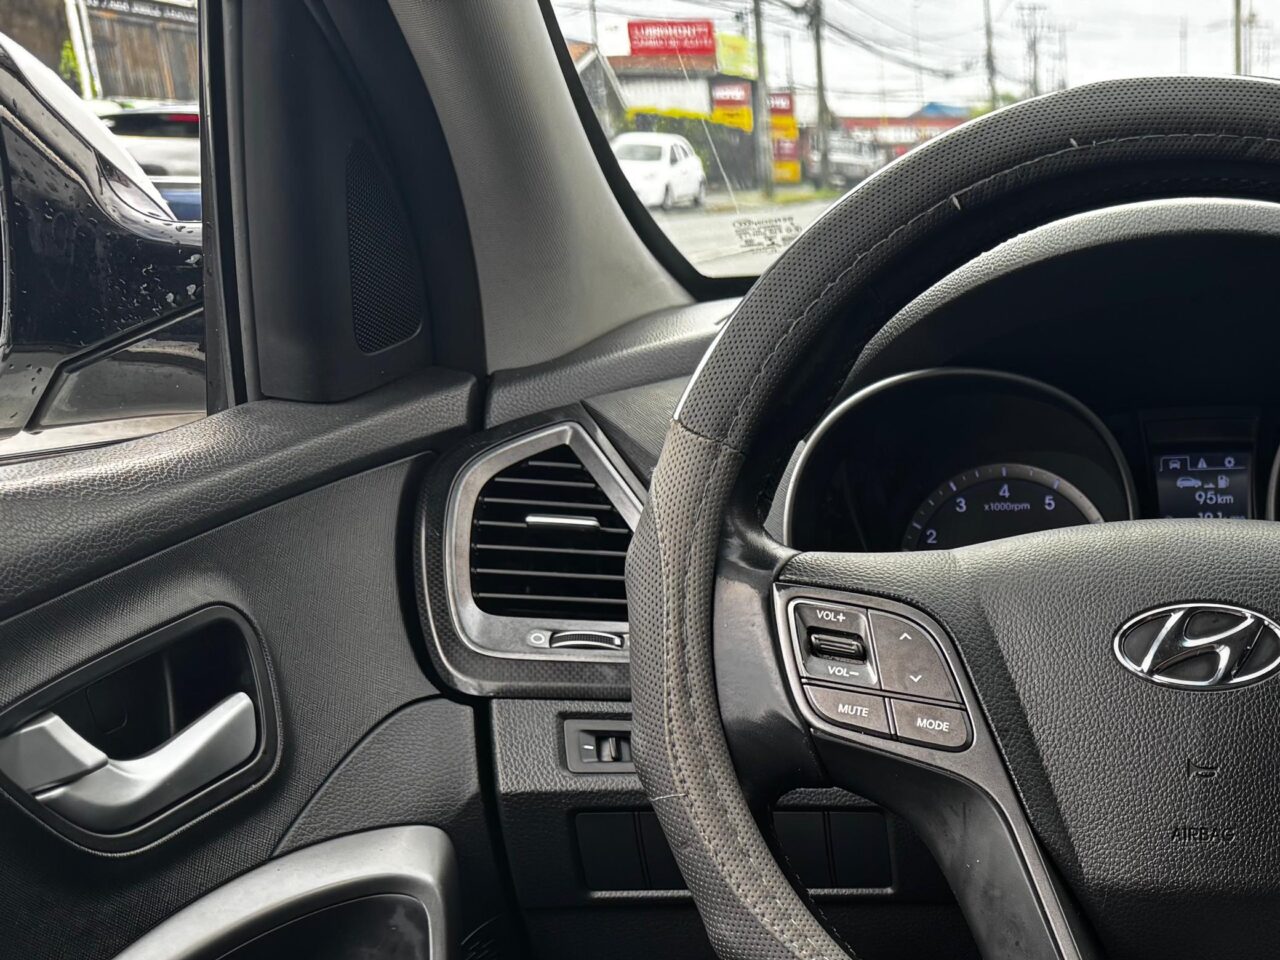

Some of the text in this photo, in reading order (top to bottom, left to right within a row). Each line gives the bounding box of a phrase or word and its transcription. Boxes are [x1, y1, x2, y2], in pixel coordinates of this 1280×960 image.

[999, 484, 1010, 498] 4
[1195, 491, 1234, 505] 95 km
[955, 497, 967, 513] 3
[983, 502, 1031, 512] x1000rpm
[1044, 496, 1055, 511] 5
[926, 529, 937, 544] 2
[816, 609, 846, 623] VOL+
[837, 703, 869, 717] MUTE
[916, 717, 950, 732] MODE
[1171, 827, 1236, 843] AIRBAG
